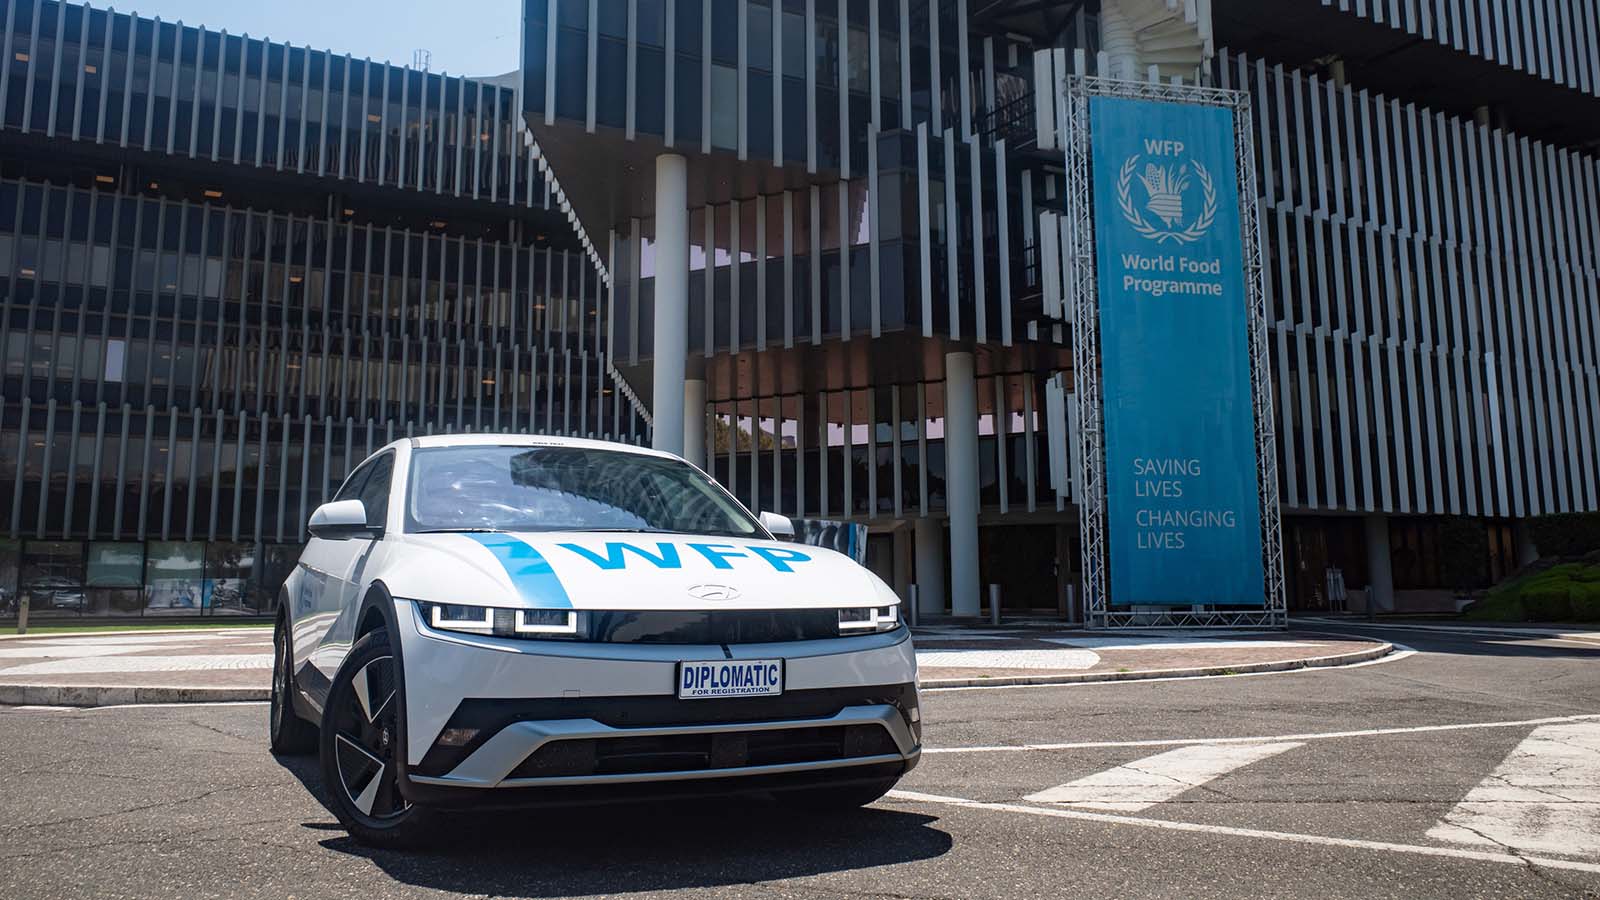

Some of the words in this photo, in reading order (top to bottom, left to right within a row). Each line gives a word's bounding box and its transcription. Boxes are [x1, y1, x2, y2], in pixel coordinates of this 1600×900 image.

[1144, 138, 1185, 157] WFP
[1121, 254, 1175, 272] World
[1179, 257, 1221, 275] Food
[1123, 275, 1223, 297] Programme
[1134, 458, 1201, 477] SAVING
[1135, 480, 1183, 498] LIVES
[1136, 509, 1236, 528] CHANGING
[1137, 531, 1185, 549] LIVES
[555, 542, 813, 573] WFP
[683, 664, 778, 689] DIPLOMATIC
[711, 686, 770, 695] REGISTRATION
